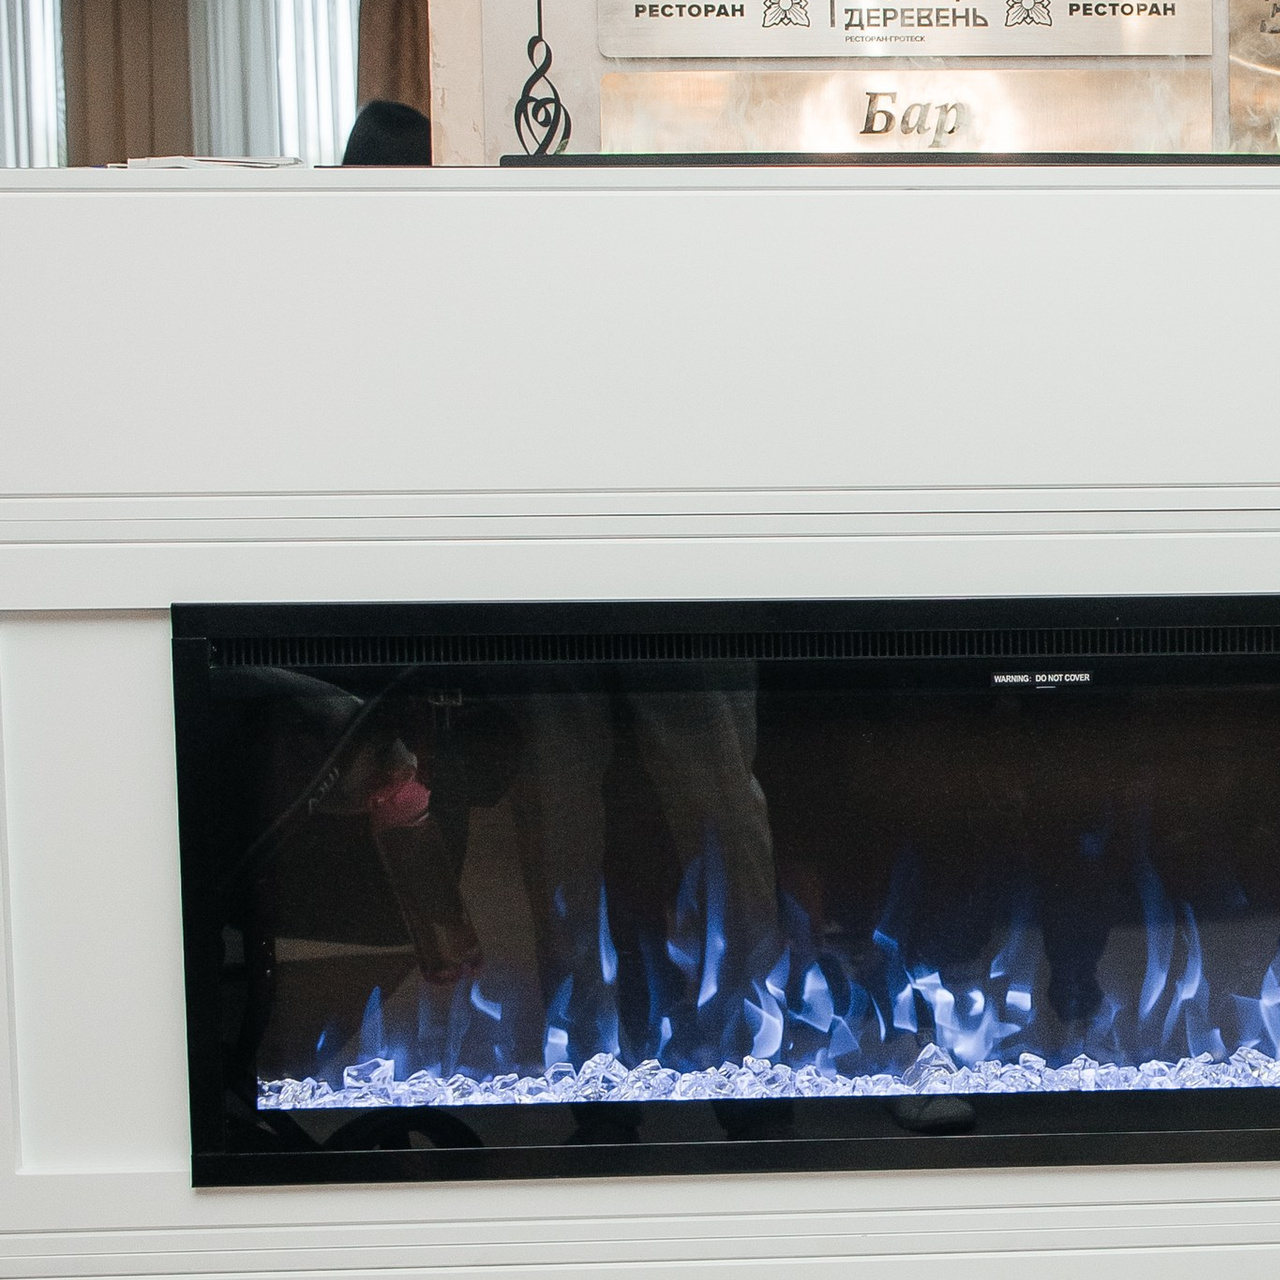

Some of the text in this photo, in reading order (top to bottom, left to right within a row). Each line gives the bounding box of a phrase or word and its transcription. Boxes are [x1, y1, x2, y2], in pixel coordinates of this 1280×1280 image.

[634, 4, 745, 18] РЕСТОРАН
[1068, 3, 1176, 16] РЕСТОРАН
[844, 7, 989, 30] ДЕРЕВЕНЬ
[859, 92, 967, 148] Бар
[994, 673, 1090, 683] WARNING: DO NOT COVER
